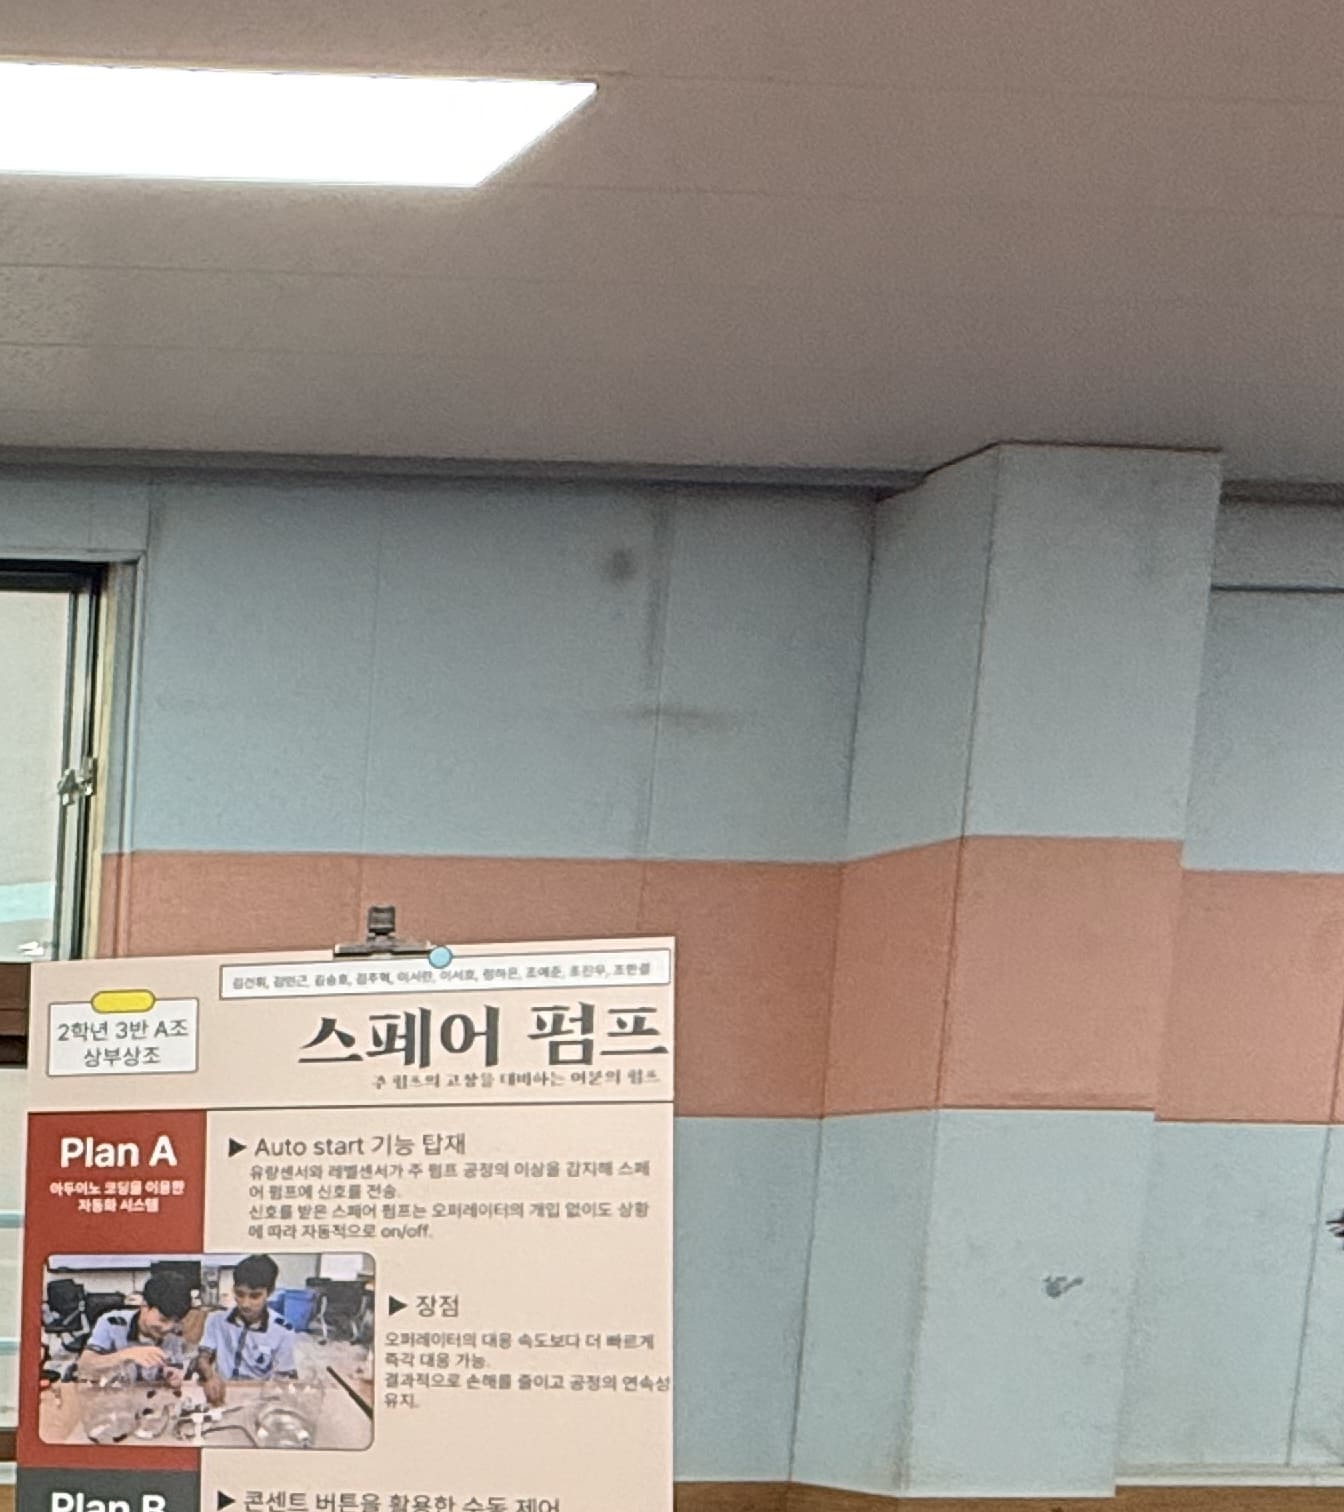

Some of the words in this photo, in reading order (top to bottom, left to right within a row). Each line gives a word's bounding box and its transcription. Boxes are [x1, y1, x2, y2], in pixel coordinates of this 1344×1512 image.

[57, 1021, 108, 1041] 2학년
[115, 1020, 148, 1040] 3반
[154, 1018, 189, 1038] A조
[298, 1005, 500, 1068] 스페어
[527, 1001, 669, 1066] 펌프
[83, 1046, 161, 1067] 상부상조
[60, 1136, 140, 1168] Plan
[148, 1134, 178, 1166] A
[254, 1137, 307, 1157] Auto
[313, 1138, 365, 1156] start
[371, 1133, 415, 1156] 기능
[422, 1132, 466, 1156] 탑재
[250, 1164, 323, 1181] 유량센서와
[328, 1163, 403, 1180] 레벨센서가
[408, 1163, 424, 1180] 주
[428, 1162, 458, 1179] 펌프
[463, 1161, 510, 1179] 공정의
[514, 1161, 560, 1178] 이상을
[566, 1160, 613, 1178] 감지해
[617, 1160, 651, 1177] 스페
[49, 1181, 101, 1198] 아두이노
[104, 1180, 142, 1196] 코딩을
[145, 1179, 185, 1196] 이용한
[249, 1184, 264, 1200] 어
[269, 1184, 313, 1200] 펌프에
[318, 1184, 362, 1200] 신호를
[366, 1183, 401, 1200] 전송.
[77, 1197, 117, 1213] 자동화
[119, 1197, 160, 1213] 시스템
[249, 1204, 293, 1220] 신호를
[297, 1204, 327, 1220] 받은
[332, 1203, 377, 1219] 스페어
[382, 1203, 427, 1220] 펌프는
[432, 1202, 524, 1219] 오퍼레이터의
[529, 1201, 560, 1218] 개입
[565, 1201, 613, 1218] 없이도
[618, 1201, 649, 1218] 상황
[248, 1224, 264, 1239] 에
[267, 1223, 297, 1239] 따라
[301, 1223, 377, 1239] 자동적으로
[381, 1223, 433, 1240] on/off.
[415, 1294, 460, 1318] 장점
[384, 1331, 477, 1348] 오퍼레이터의
[480, 1331, 513, 1349] 대응
[518, 1332, 581, 1349] 속도보다
[585, 1333, 602, 1349] 더
[606, 1333, 655, 1350] 빠르게
[384, 1352, 415, 1369] 즉각
[419, 1352, 450, 1369] 대응
[455, 1352, 491, 1370] 가능.
[384, 1372, 460, 1389] 결과적으로
[465, 1373, 513, 1390] 손해를
[517, 1374, 565, 1390] 줄이고
[569, 1374, 617, 1392] 공정의
[622, 1375, 670, 1392] 연속성
[384, 1393, 419, 1409] 유지.
